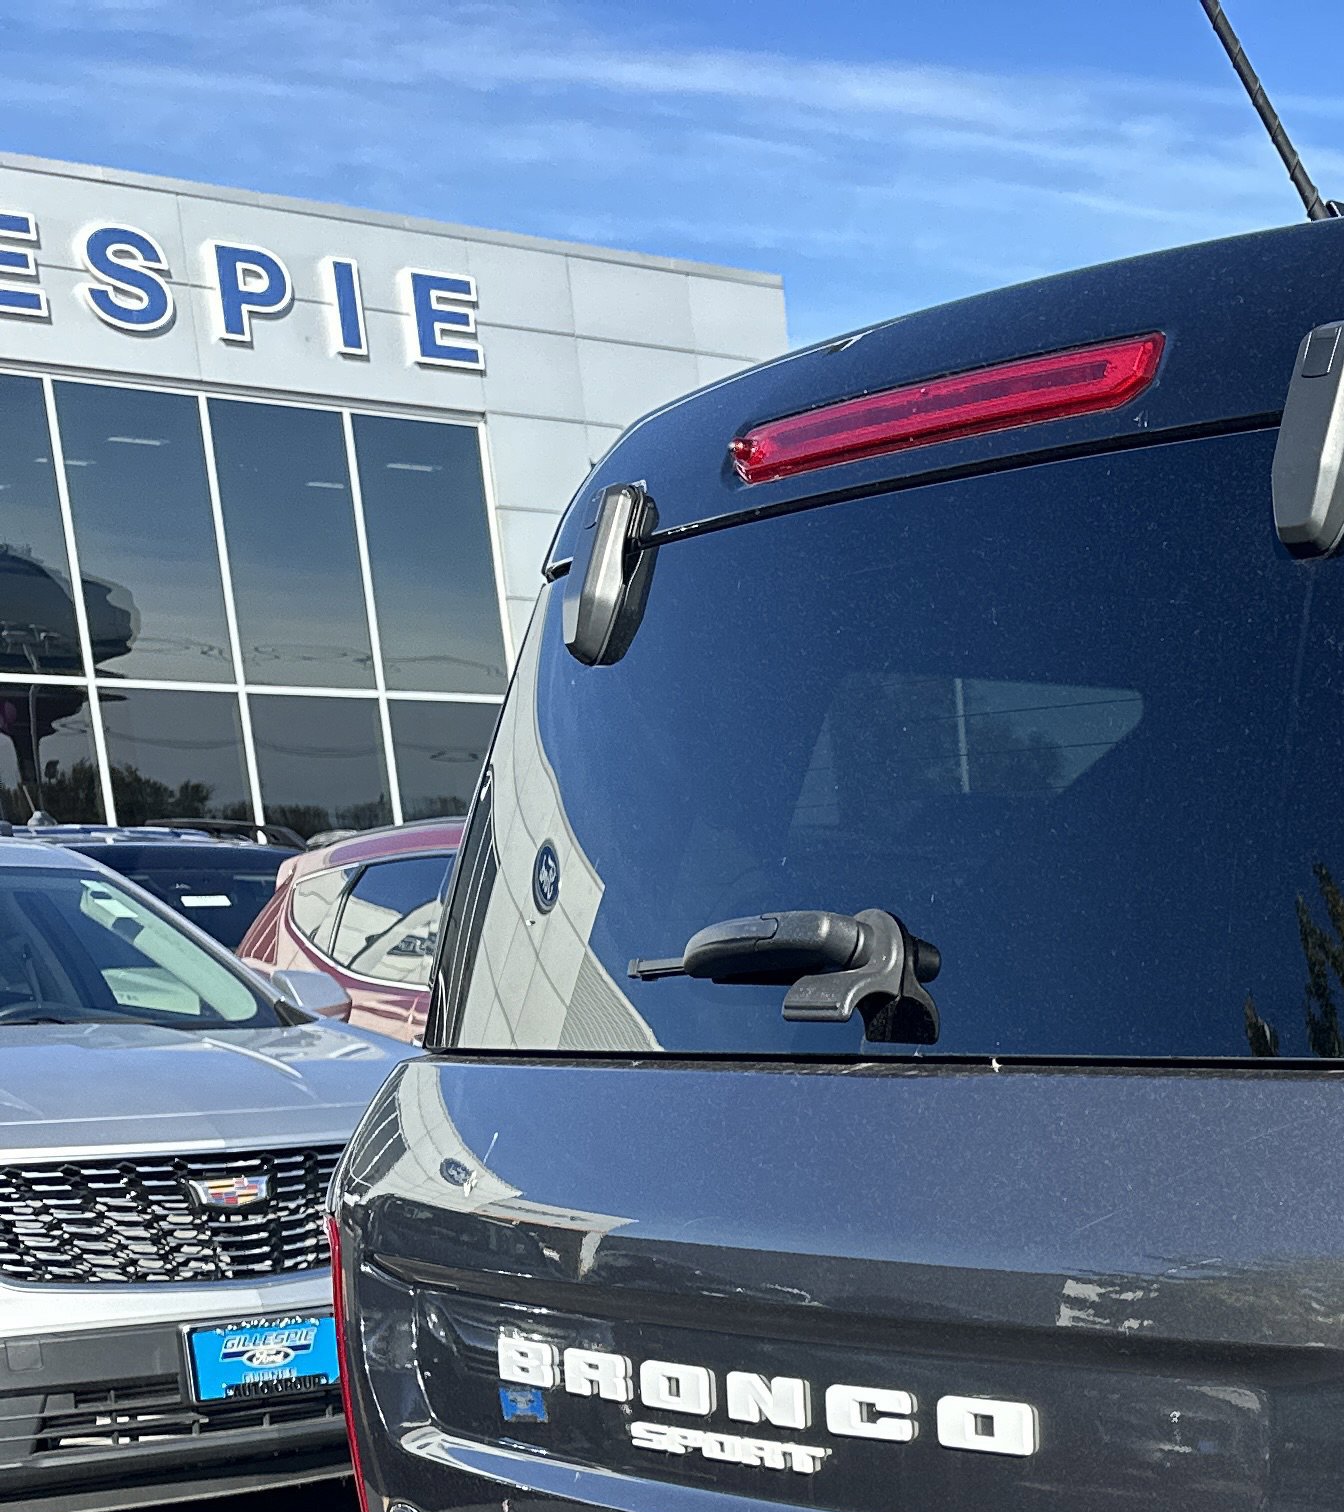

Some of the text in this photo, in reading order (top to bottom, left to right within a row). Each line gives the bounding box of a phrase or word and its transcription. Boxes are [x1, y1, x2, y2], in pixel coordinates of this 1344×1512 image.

[224, 1328, 317, 1350] GILLESPIE
[233, 1377, 320, 1399] AUTO GROUP
[499, 1337, 1040, 1457] BRONCO
[630, 1420, 832, 1474] SPORT
